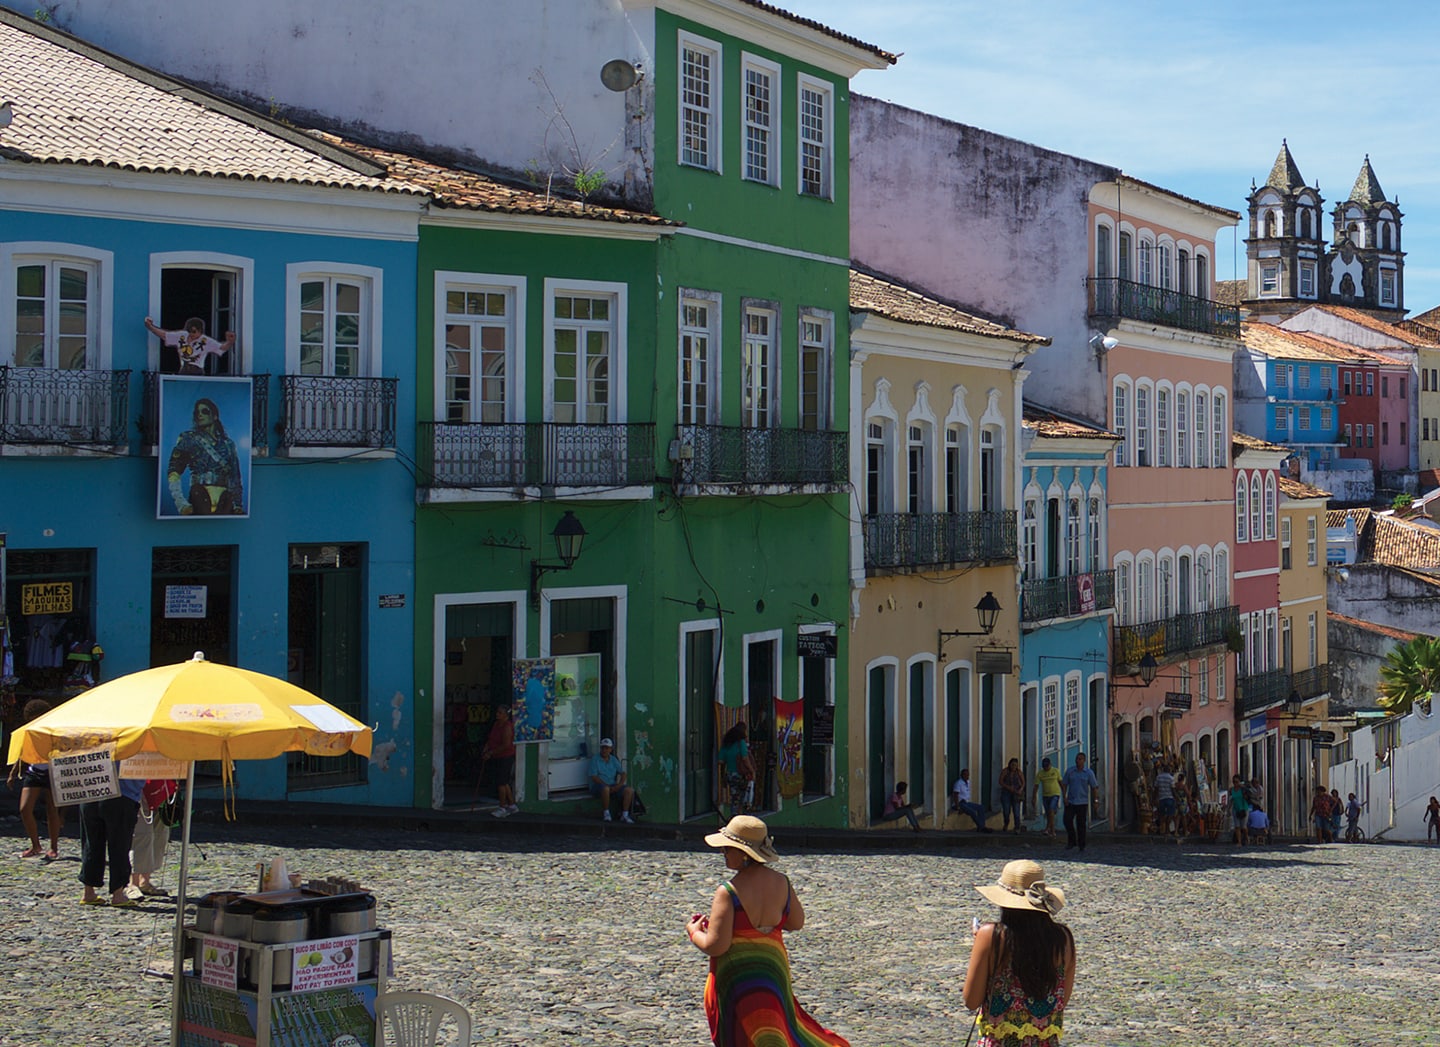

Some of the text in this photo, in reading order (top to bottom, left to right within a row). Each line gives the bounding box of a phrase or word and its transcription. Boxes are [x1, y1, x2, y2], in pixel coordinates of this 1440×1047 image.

[24, 585, 70, 597] FILMES
[24, 603, 70, 613] E PILHAS
[54, 757, 77, 766] DINHEIRO
[88, 750, 110, 762] SERVE
[60, 764, 104, 777] PARA 3 COISAS:
[84, 775, 110, 786] GASTAR
[62, 787, 112, 801] E PASSAR TROCO.
[317, 941, 331, 950] LIMÃO
[337, 962, 354, 970] PARA
[299, 970, 351, 982] EXPERIMENTAR
[334, 976, 355, 984] PROVE
[337, 1038, 355, 1047] COCO
